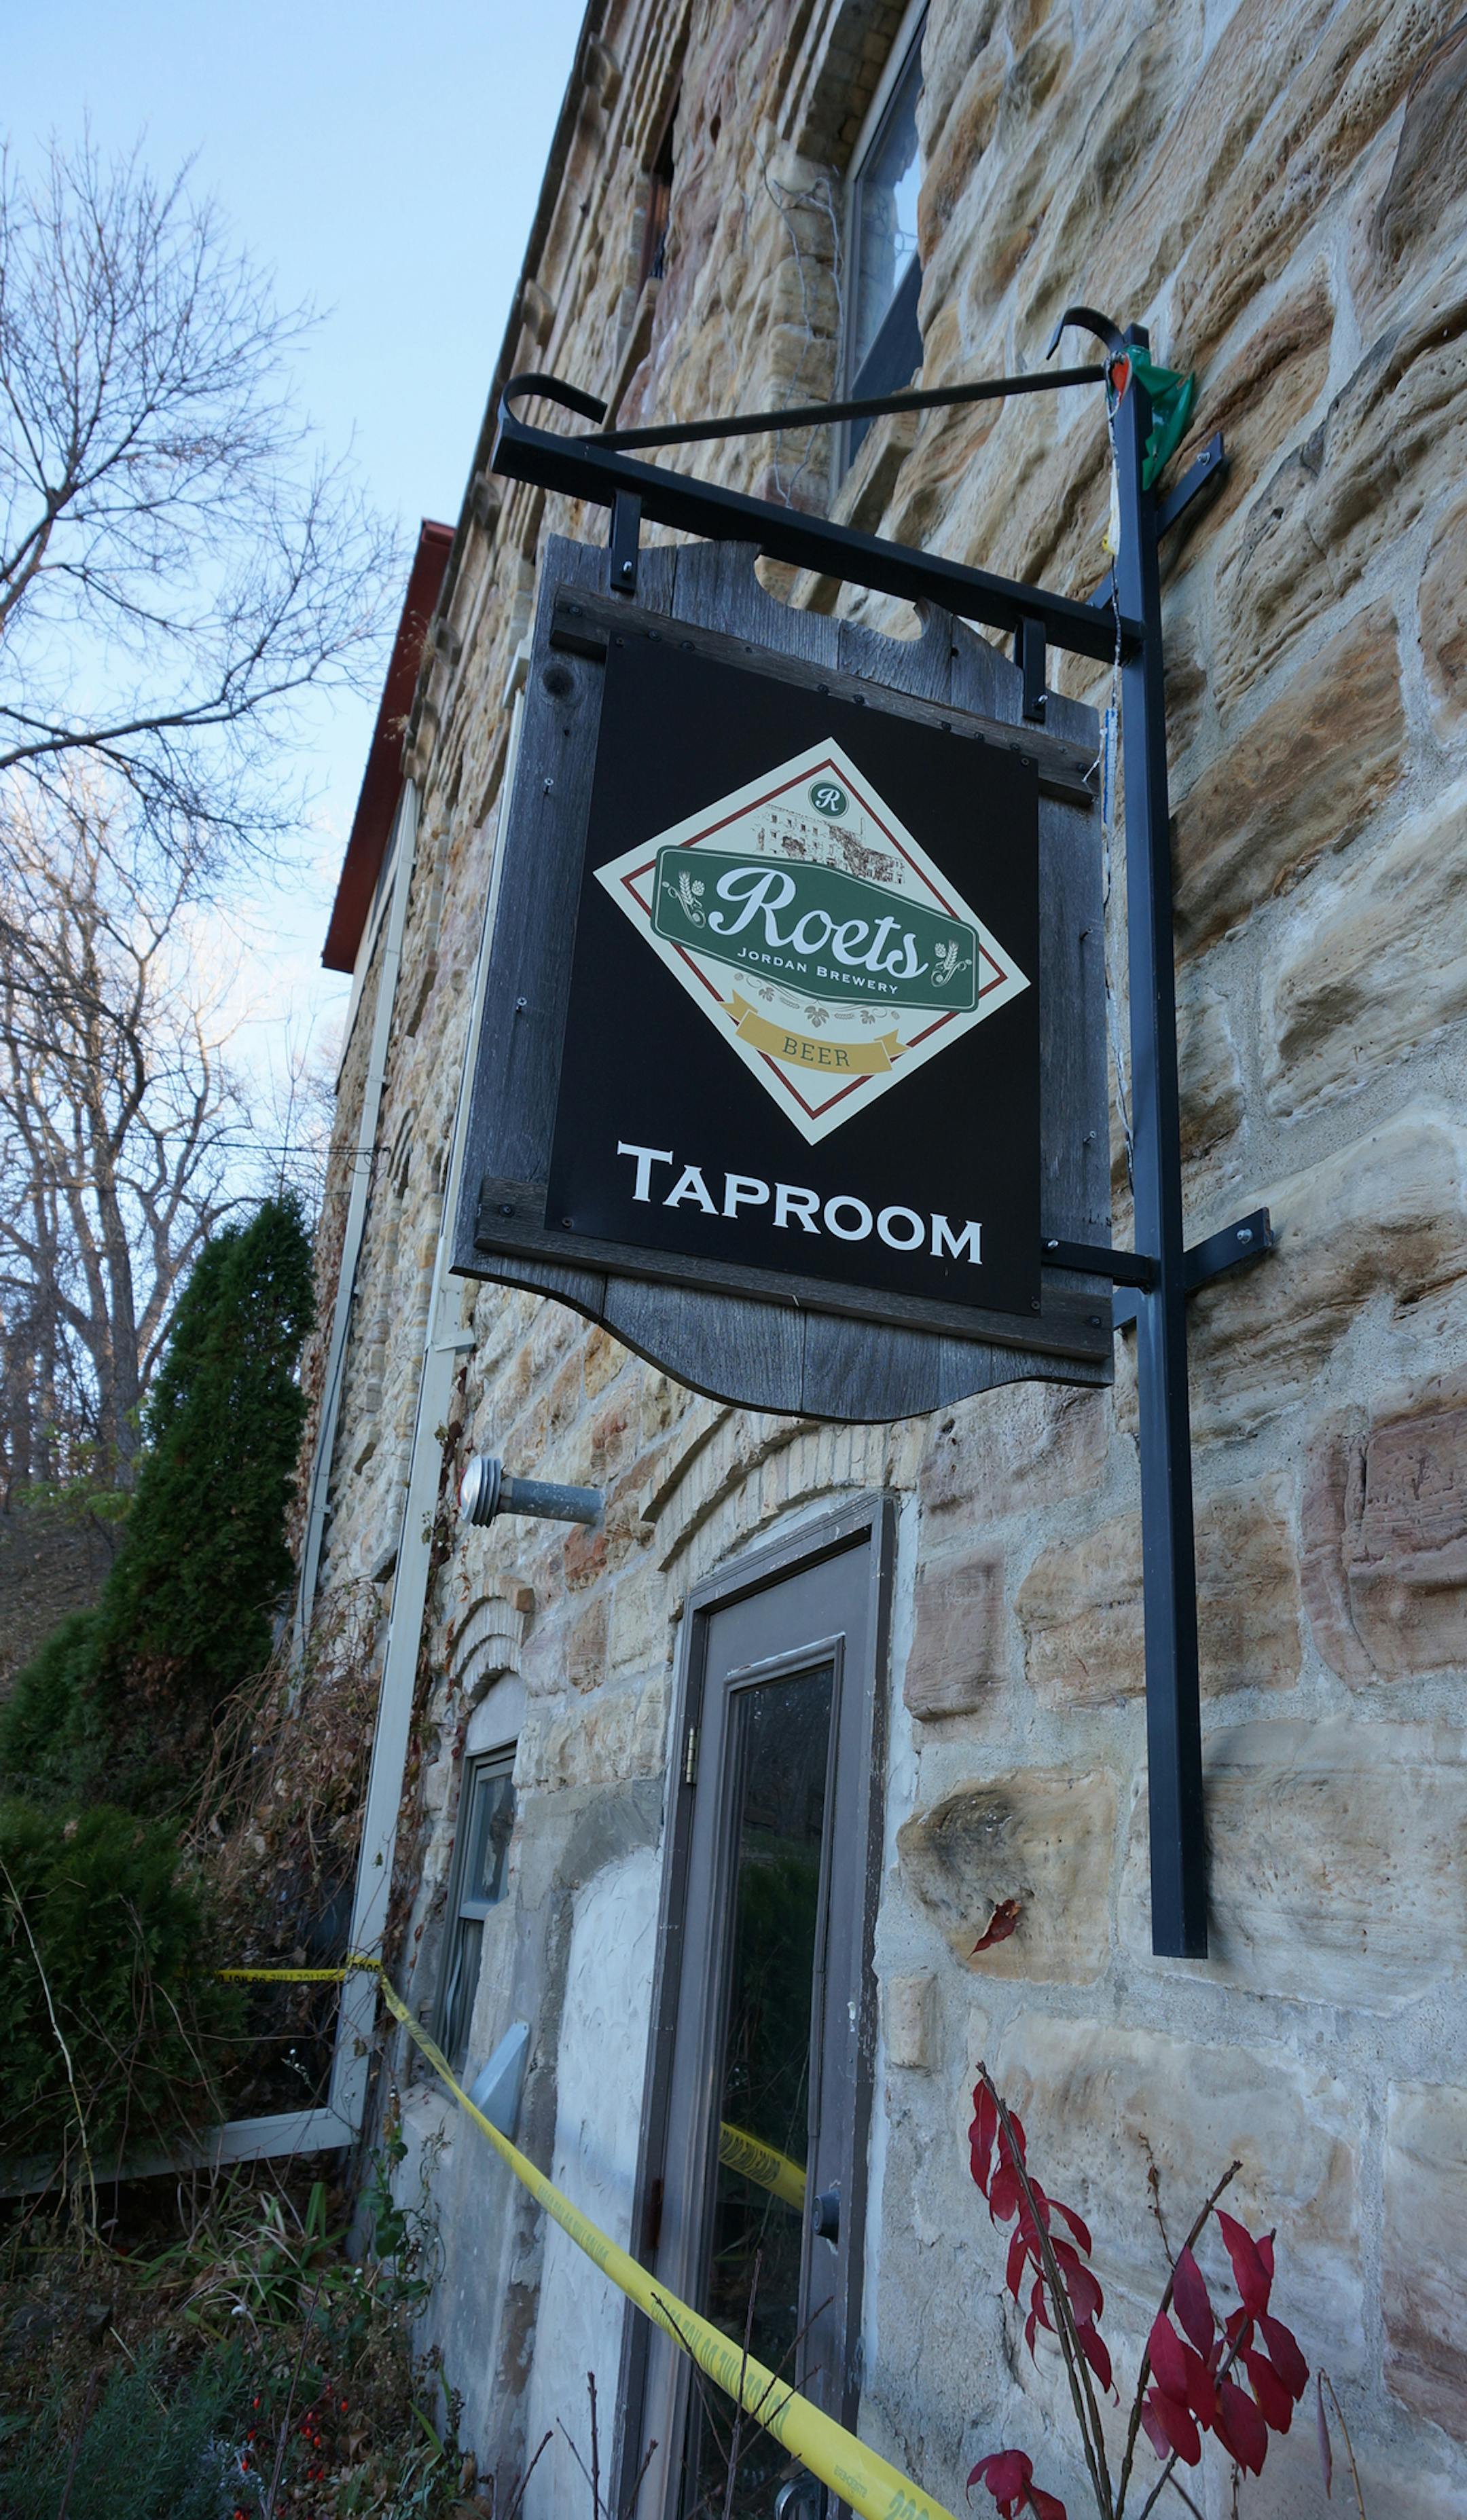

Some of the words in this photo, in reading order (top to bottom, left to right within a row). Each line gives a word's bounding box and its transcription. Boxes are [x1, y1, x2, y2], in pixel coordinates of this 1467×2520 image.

[815, 788, 840, 811] R
[707, 866, 930, 979] Roets
[737, 947, 808, 973] JORDAN
[816, 965, 900, 995] BREWERY
[781, 1036, 852, 1067] BEER
[617, 1140, 983, 1265] TAPROOM
